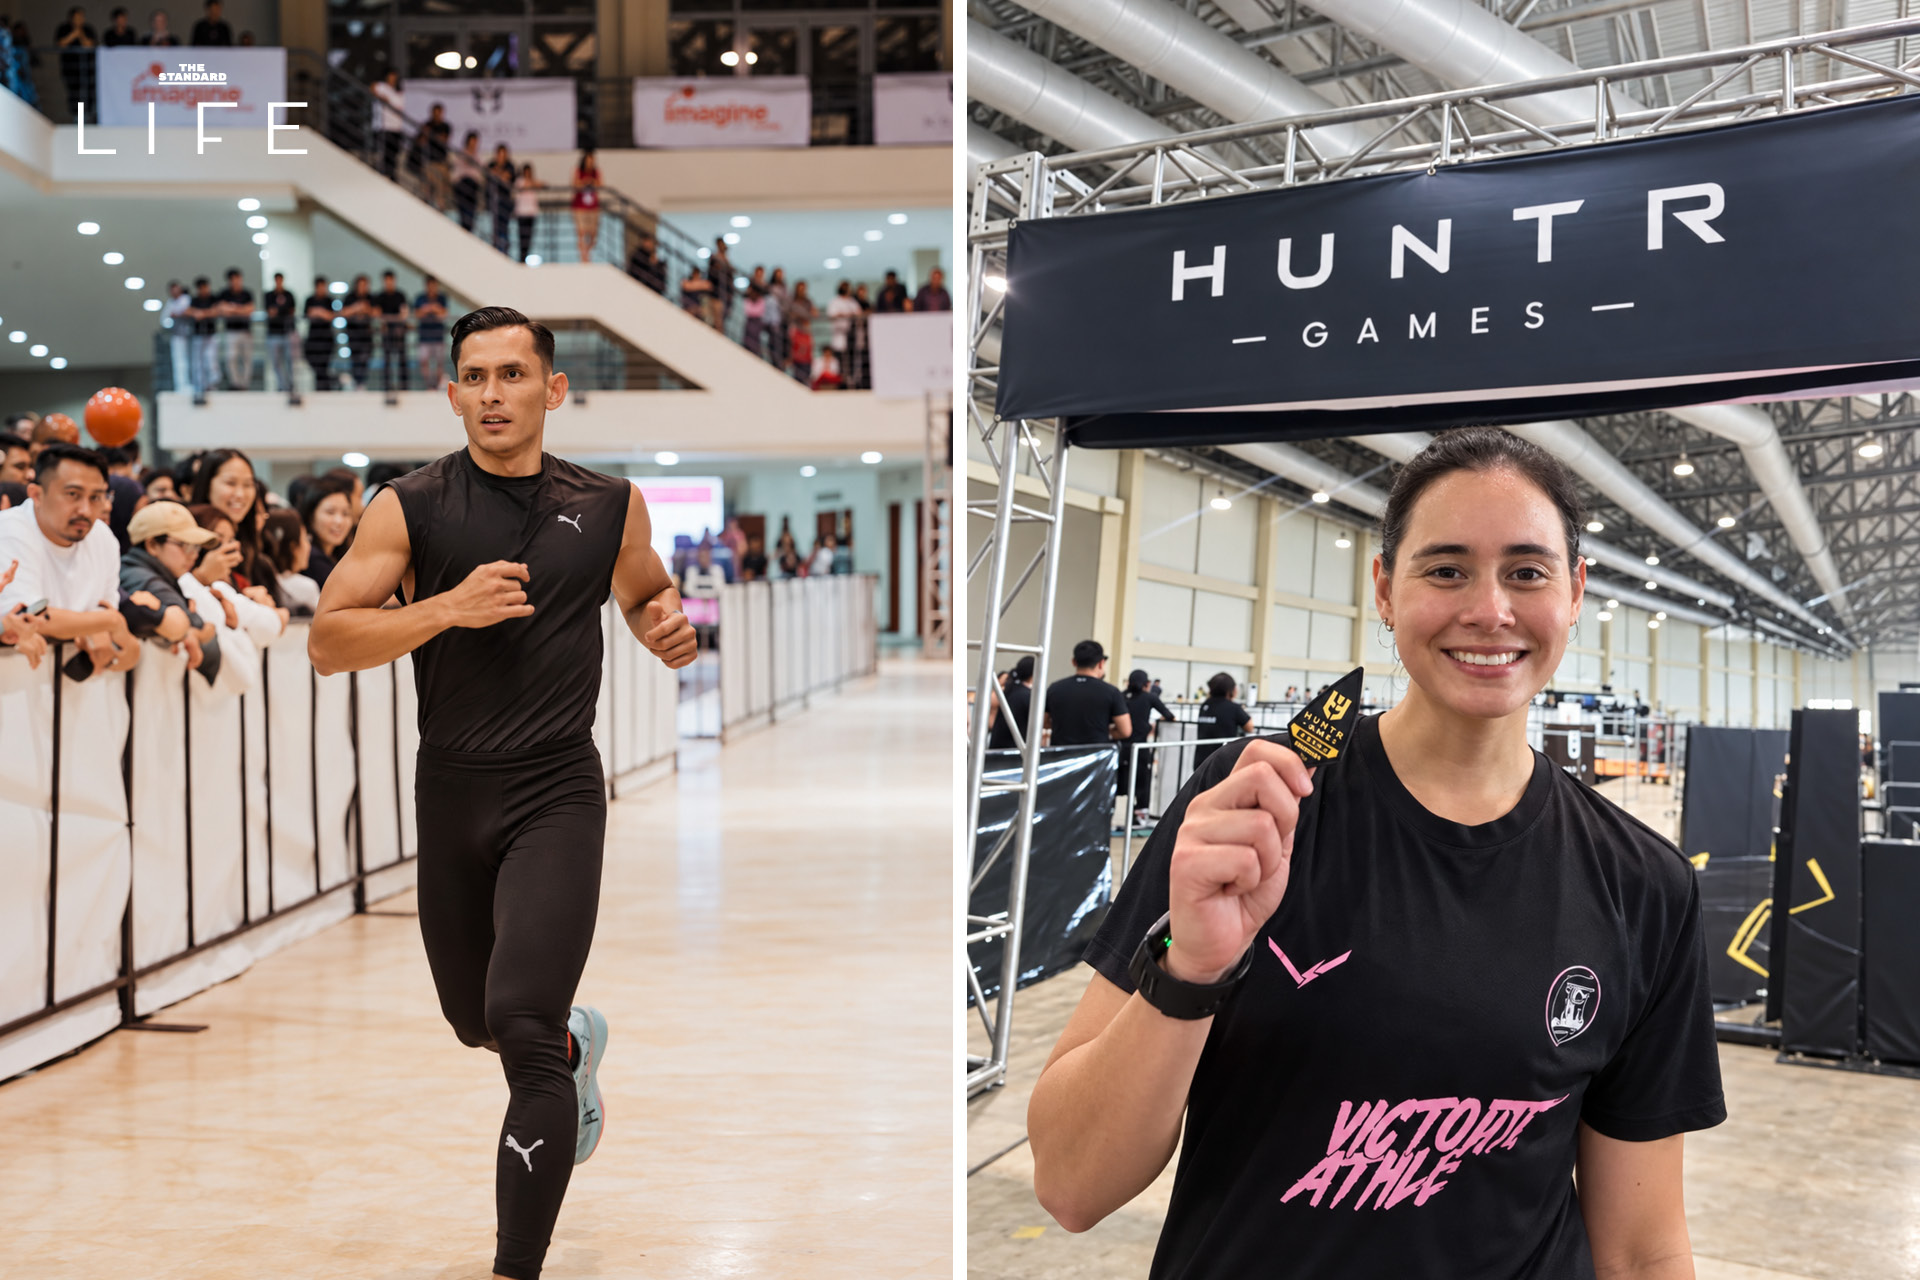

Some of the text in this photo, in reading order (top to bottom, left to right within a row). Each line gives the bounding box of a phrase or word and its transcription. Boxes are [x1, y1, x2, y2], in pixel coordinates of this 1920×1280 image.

[1171, 181, 1726, 302] HUNTR
[1301, 300, 1546, 349] GAMES
[1303, 711, 1344, 740] HUNTR
